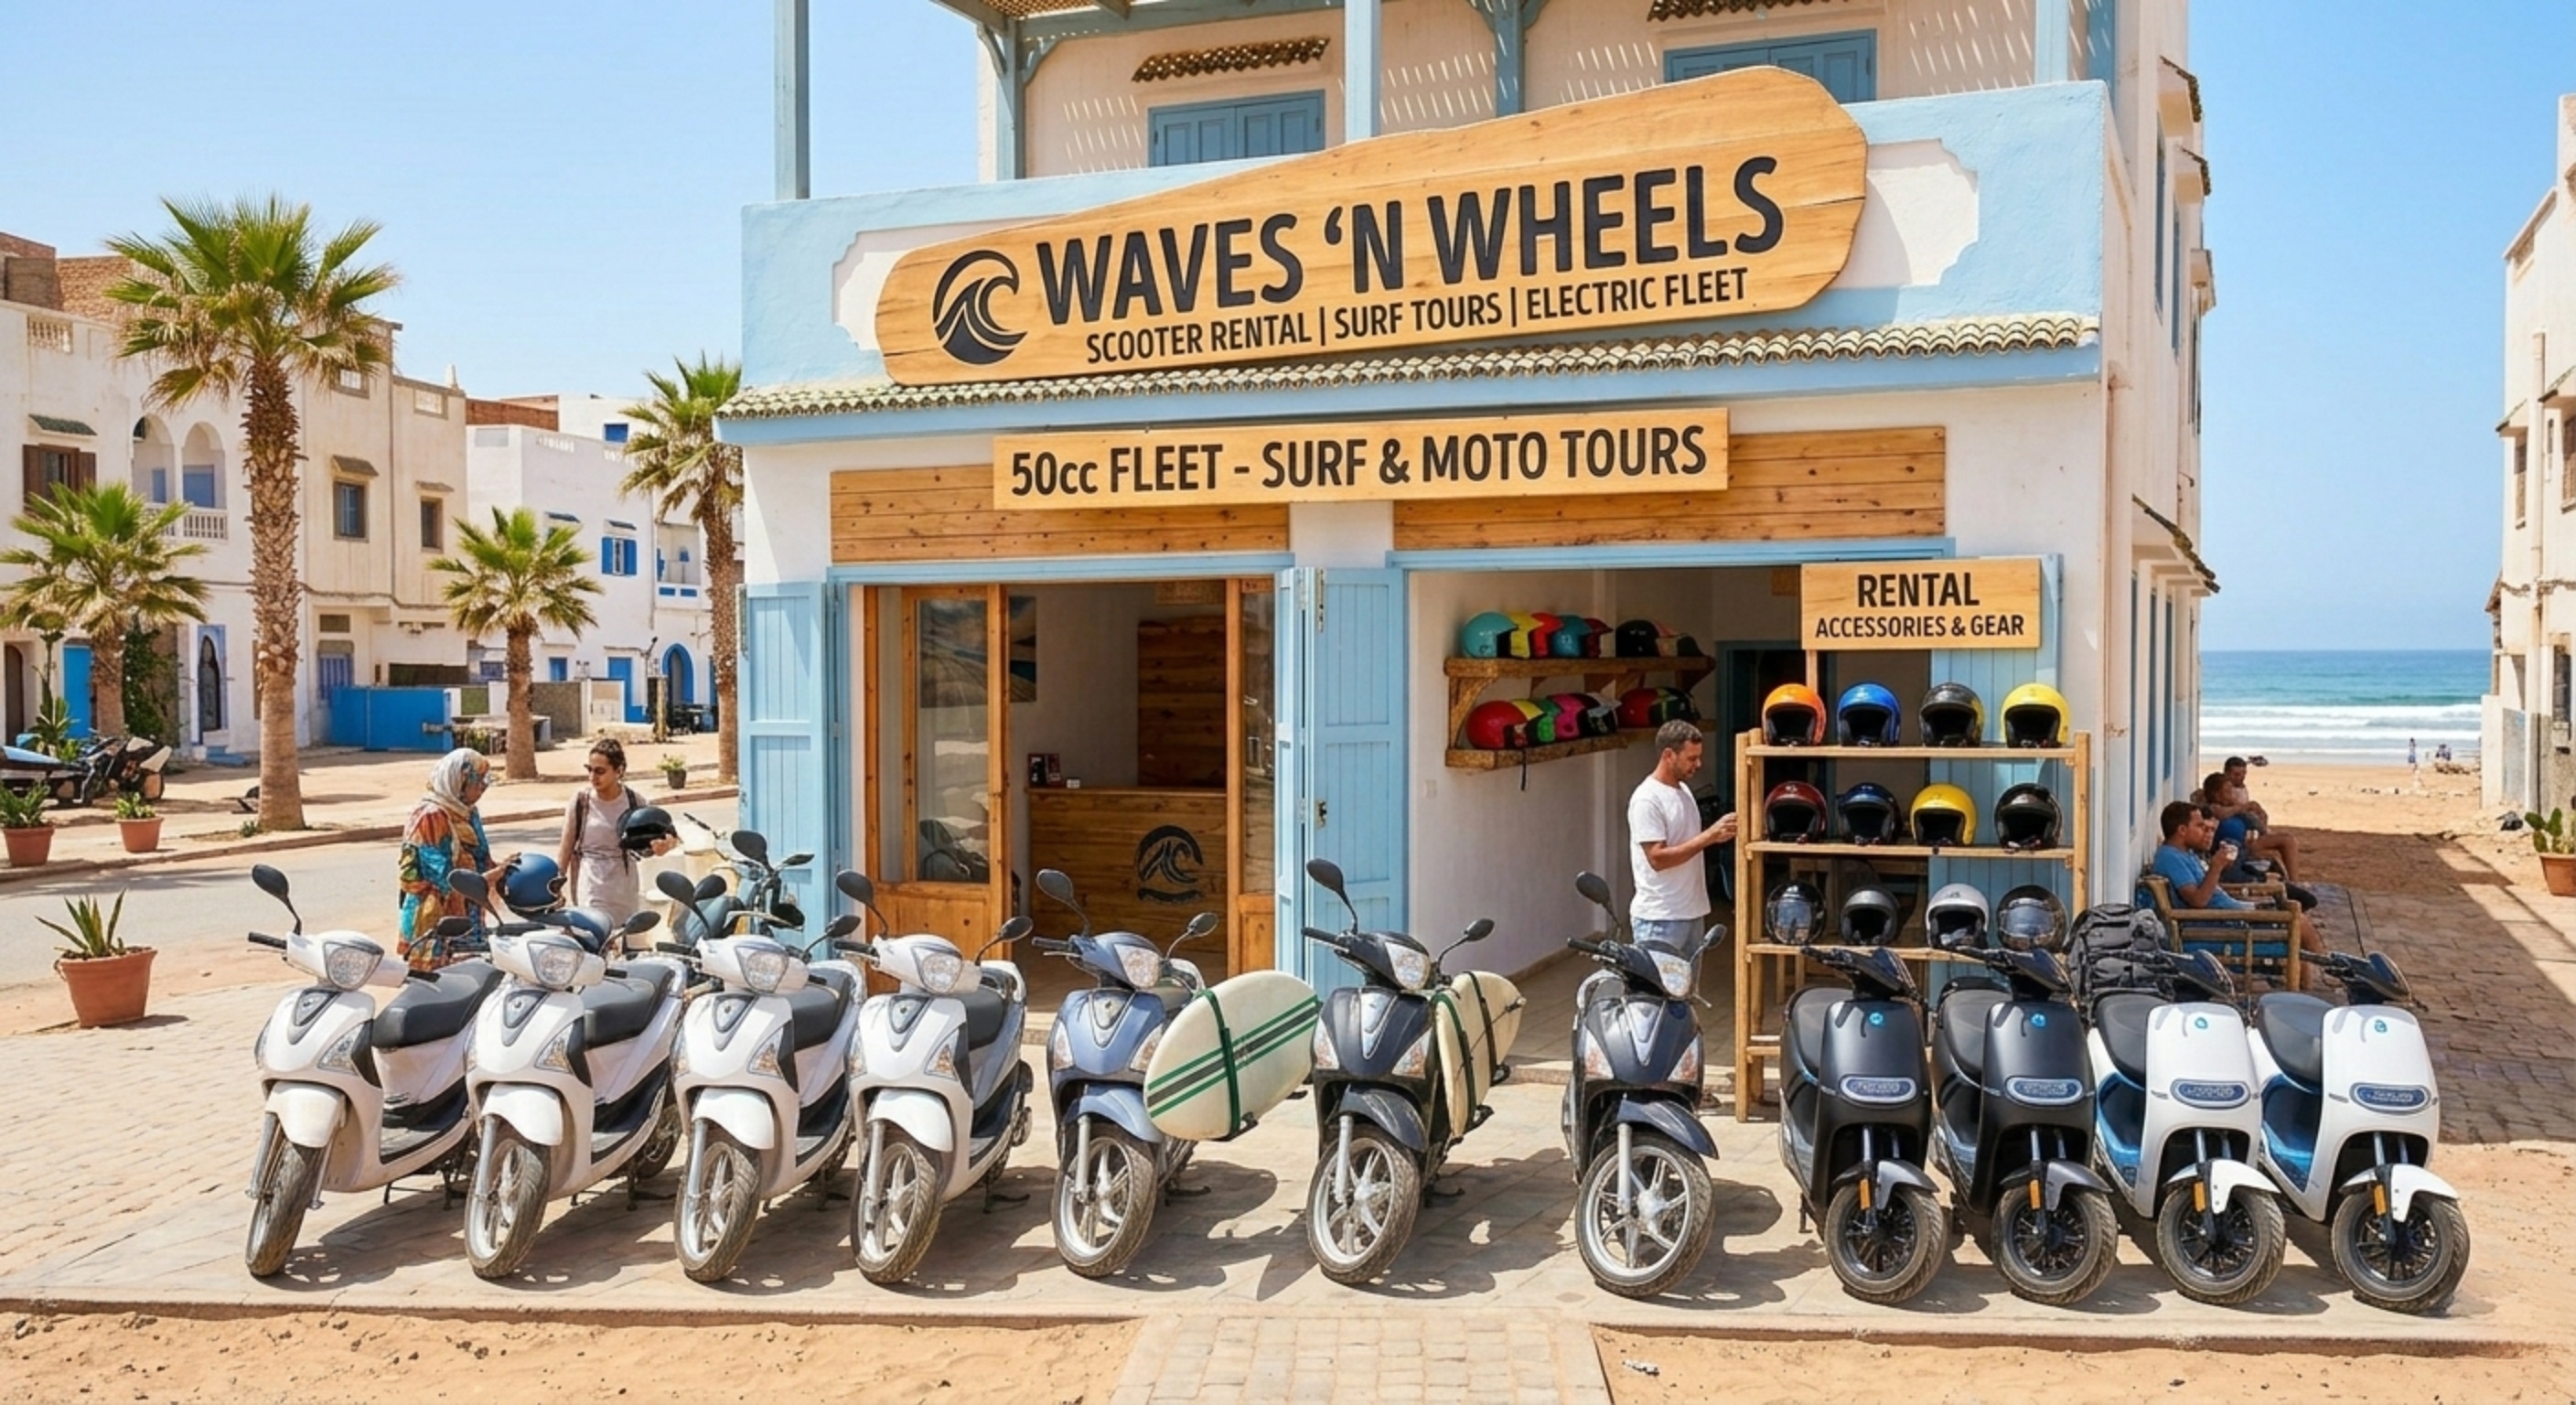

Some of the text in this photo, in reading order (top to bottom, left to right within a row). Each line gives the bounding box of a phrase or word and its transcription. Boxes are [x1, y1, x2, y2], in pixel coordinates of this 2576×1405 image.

[1036, 213, 1304, 326] WAVES
[1426, 156, 1784, 284] WHEELS
[1087, 320, 1204, 364] SCOOTER
[1210, 312, 1312, 353] RENTAL
[1335, 302, 1403, 339] SURF
[1410, 294, 1503, 331] TOURS
[1527, 278, 1657, 320] ELECTRIC
[1665, 267, 1749, 307] FLEET
[1012, 451, 1099, 497] 50cc
[1111, 444, 1223, 493] FLEET
[1261, 438, 1368, 488] SURF
[1379, 438, 1411, 485] &
[1422, 431, 1548, 482] MOTO
[1560, 424, 1708, 478] TOURS
[1815, 614, 2025, 638] ACCESSORIES & GEAR
[1857, 572, 1980, 608] RENTAL
